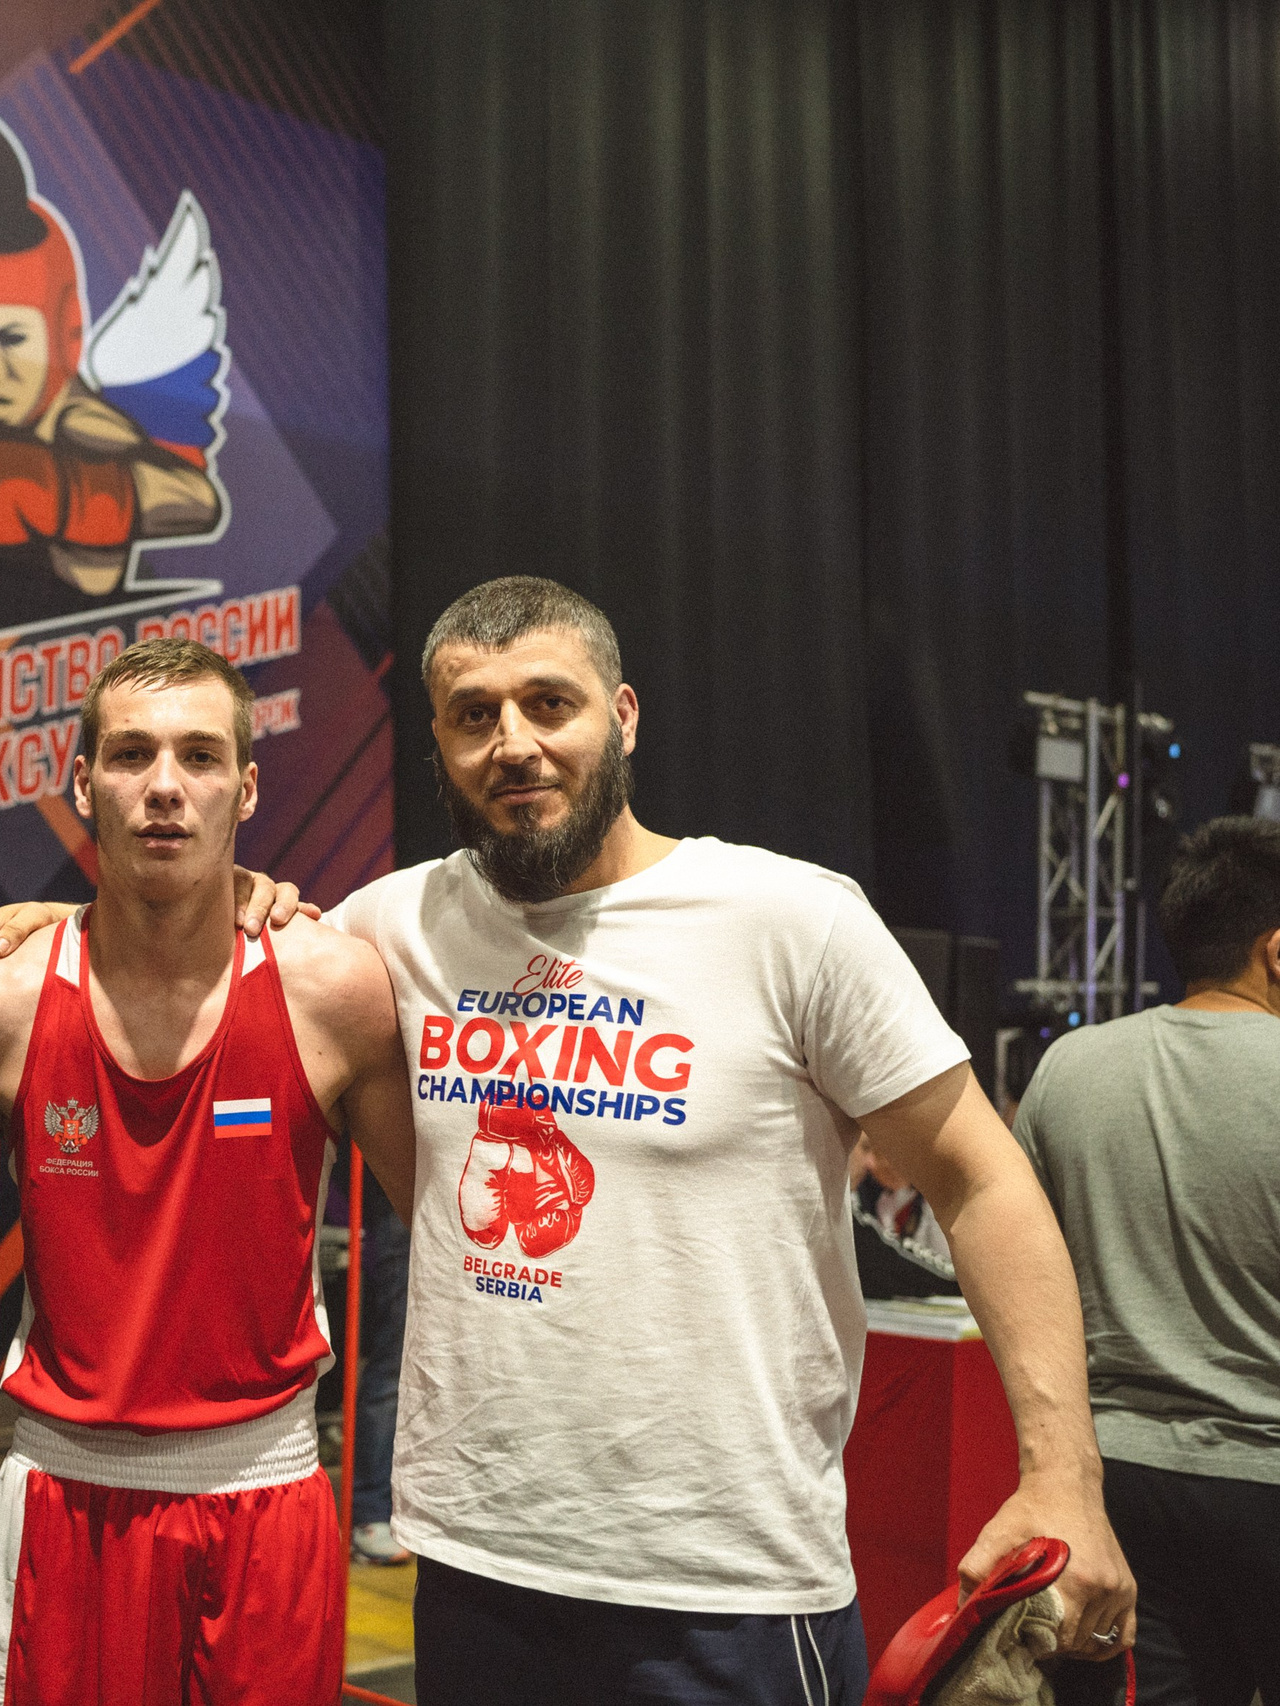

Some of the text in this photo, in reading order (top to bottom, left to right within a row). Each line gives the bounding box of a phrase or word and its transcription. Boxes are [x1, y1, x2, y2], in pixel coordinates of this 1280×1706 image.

[513, 954, 584, 996] Elite
[457, 989, 645, 1026] EUROPEAN
[419, 1015, 695, 1092] BOXING
[417, 1074, 687, 1126] CHAMPIONSHIPS
[39, 1165, 99, 1177] БОКСА РОССИИ
[45, 1158, 93, 1168] ФЕДЕРАЦИЯ
[463, 1256, 563, 1288] BELGRADE
[475, 1277, 543, 1303] SERBIA
